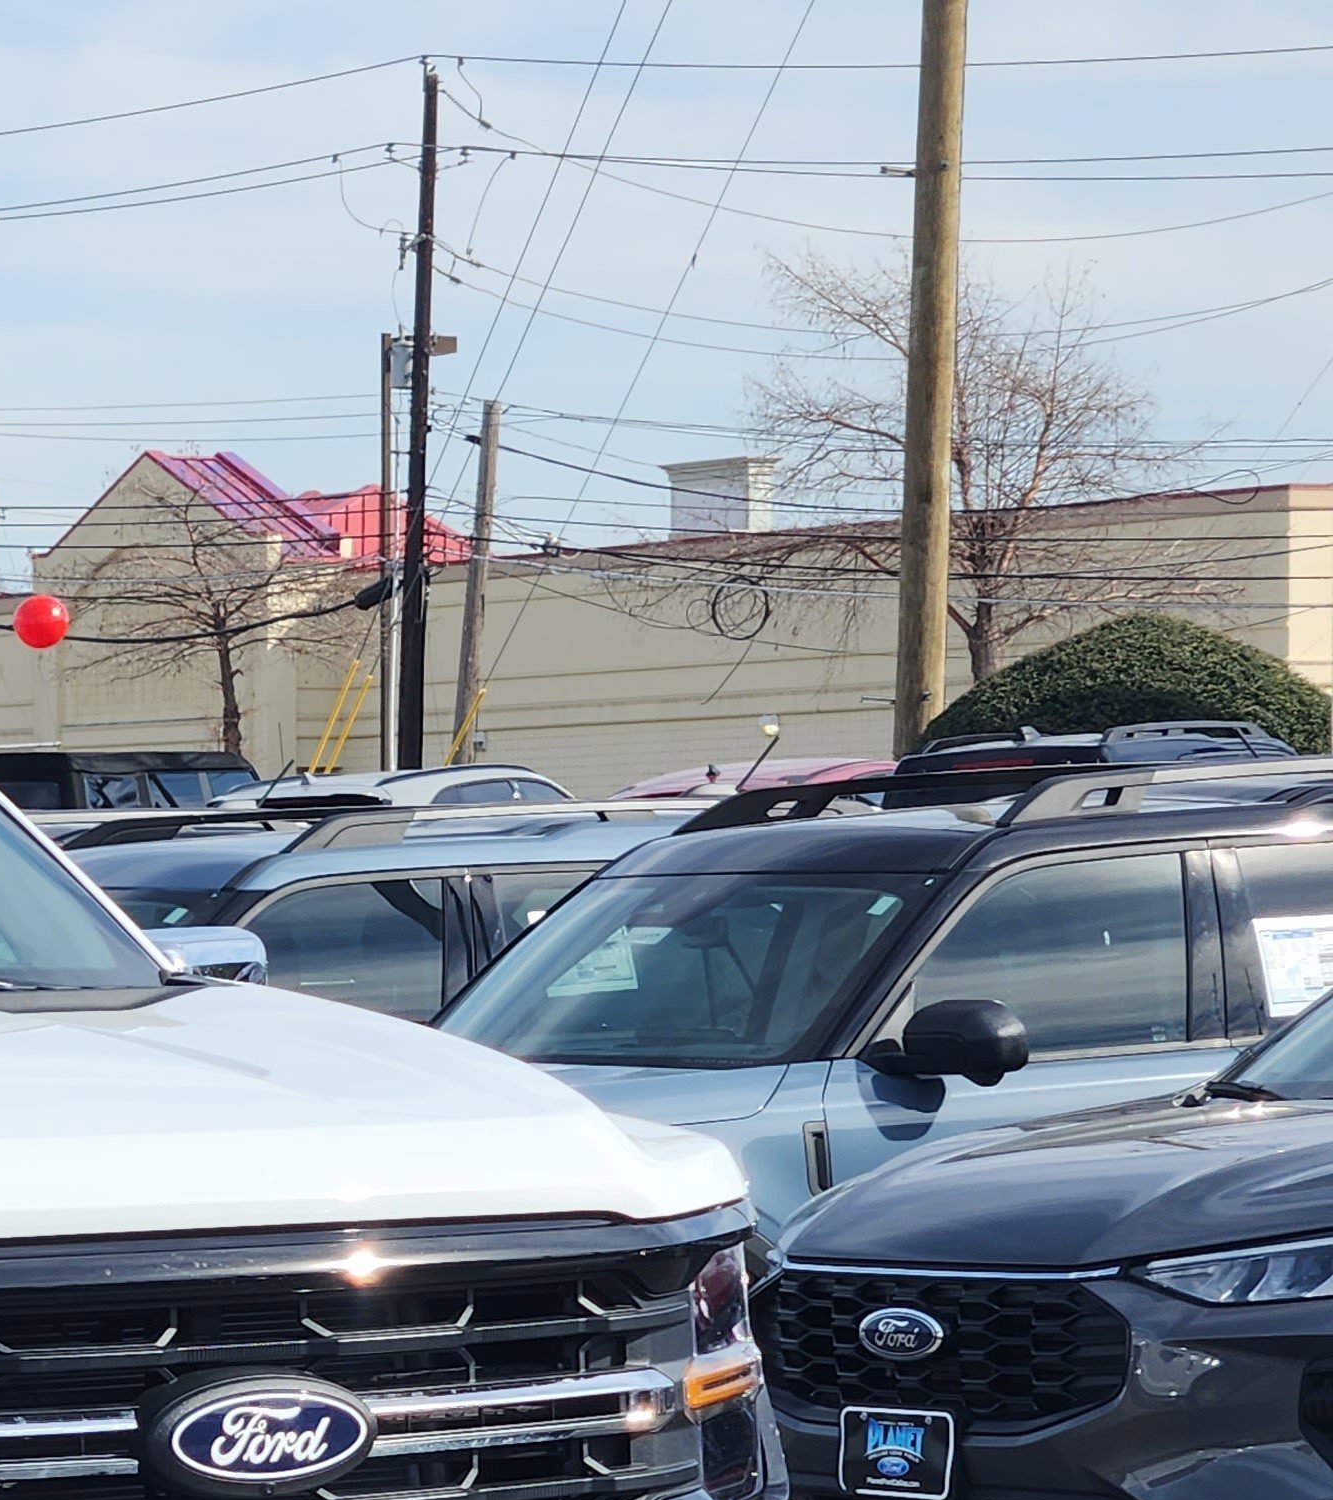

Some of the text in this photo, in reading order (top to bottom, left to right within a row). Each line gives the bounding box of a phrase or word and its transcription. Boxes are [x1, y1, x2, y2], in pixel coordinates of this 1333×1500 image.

[874, 1318, 920, 1348] Ford
[210, 1406, 331, 1467] Ford
[866, 1417, 925, 1454] PLANET
